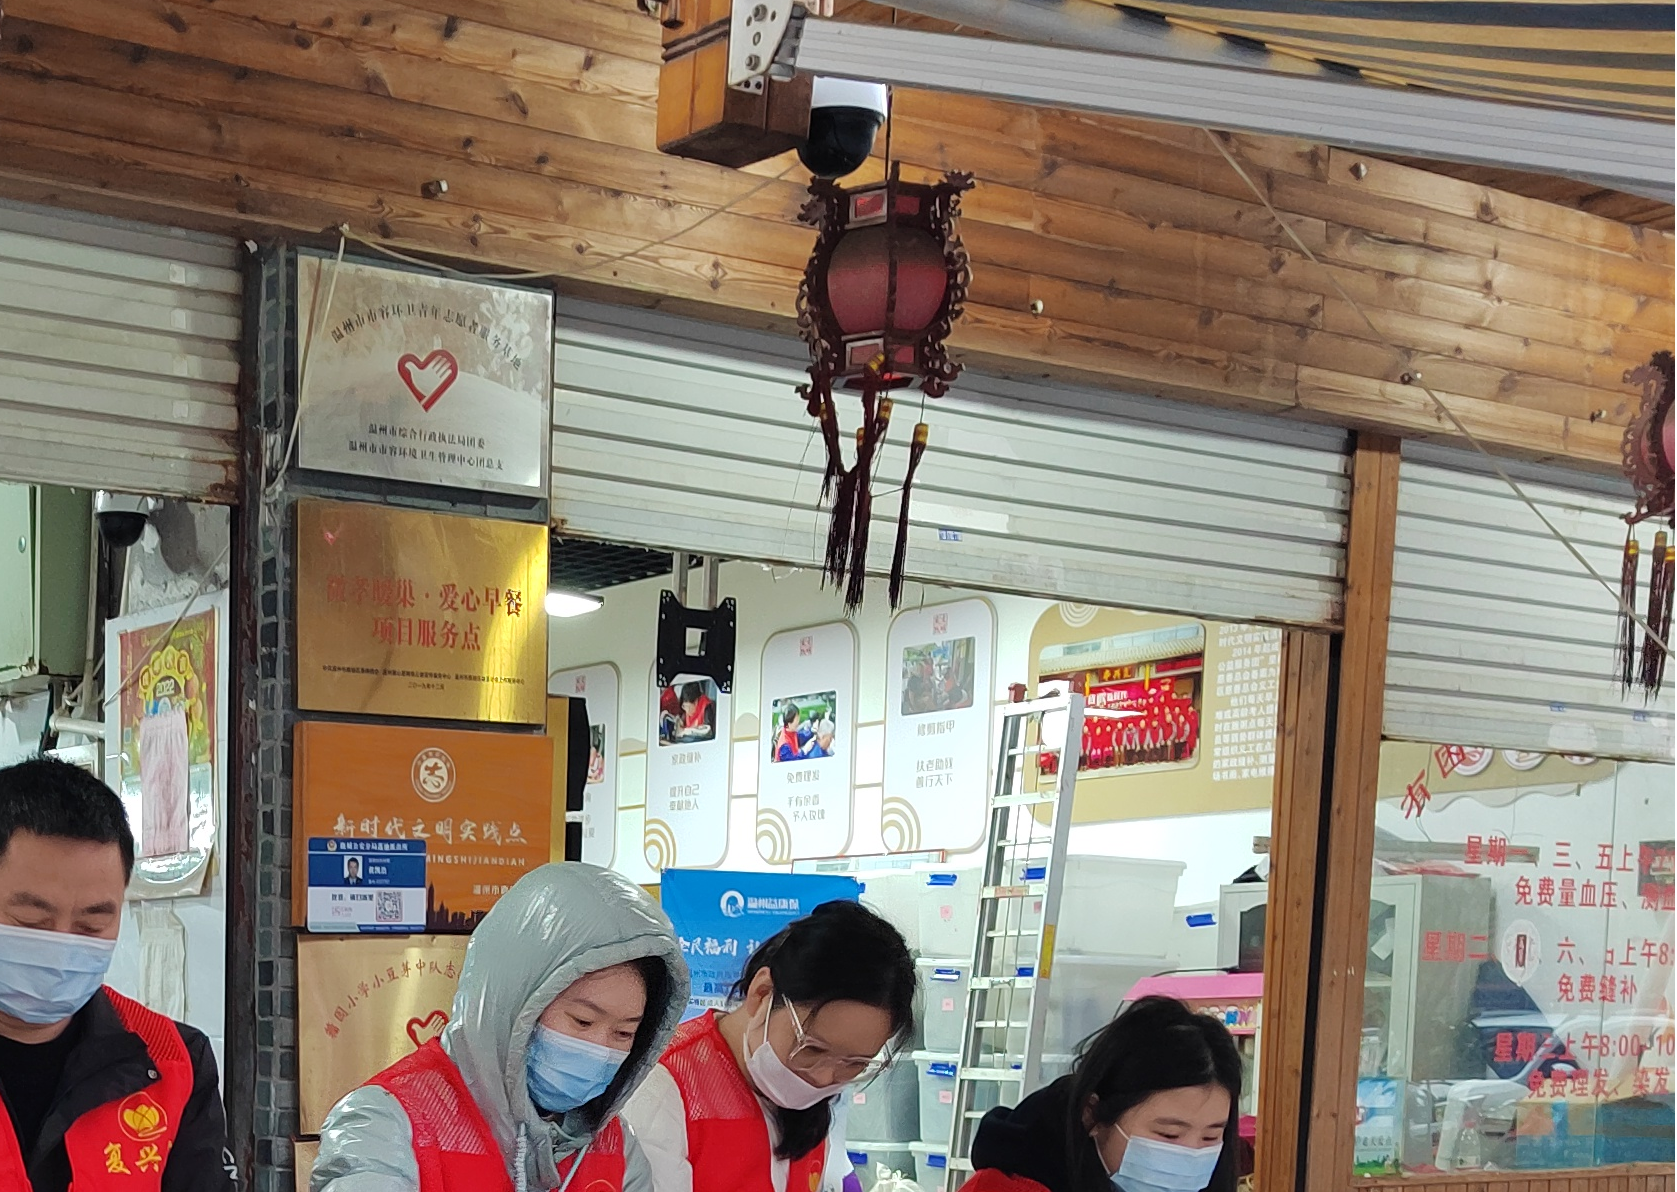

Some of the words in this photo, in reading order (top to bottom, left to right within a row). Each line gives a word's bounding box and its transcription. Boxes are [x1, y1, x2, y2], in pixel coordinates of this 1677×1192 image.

[372, 616, 481, 651] 项目服务点
[156, 677, 175, 696] 2022
[332, 813, 528, 846] 新时代文明实践点
[1557, 973, 1637, 1004] 免费缝补
[104, 1140, 172, 1175] 复兴
